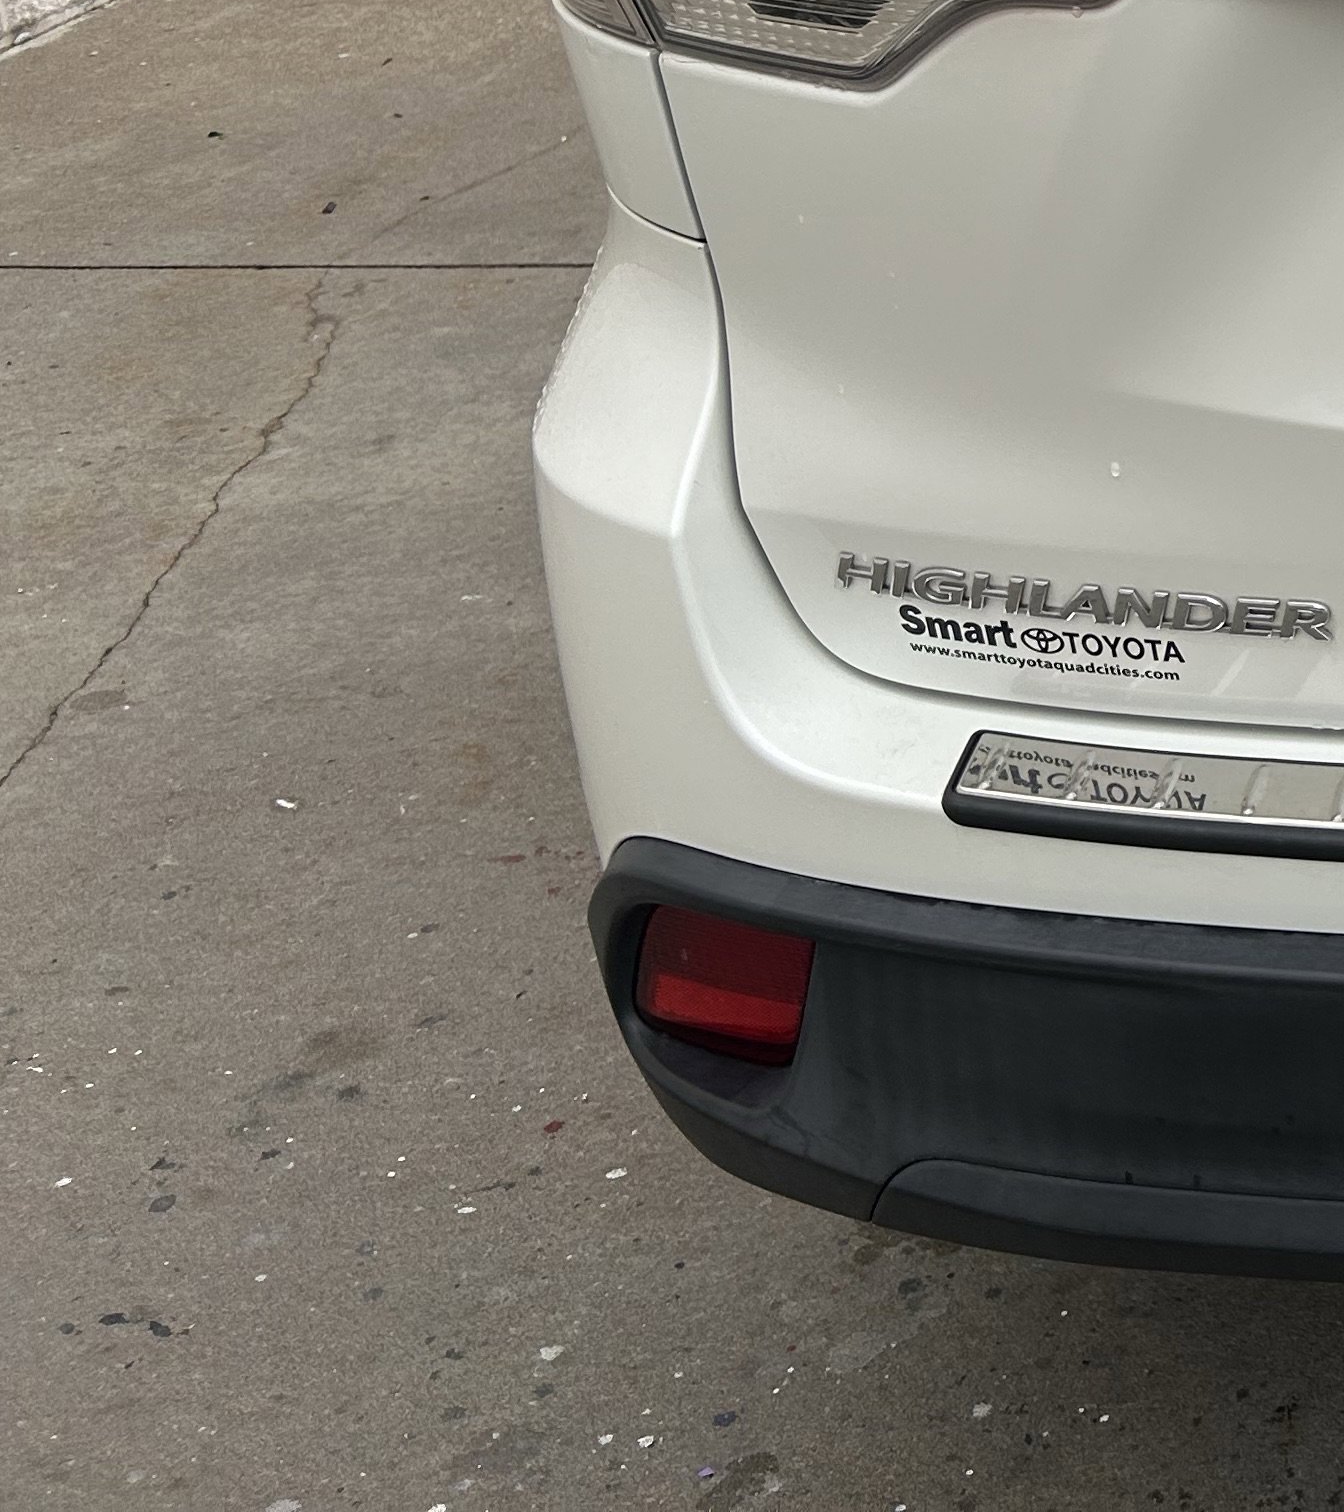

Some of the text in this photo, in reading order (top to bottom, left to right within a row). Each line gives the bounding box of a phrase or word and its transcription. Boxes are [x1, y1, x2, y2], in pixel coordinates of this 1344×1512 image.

[834, 550, 1335, 643] HIGHLANDER
[898, 605, 1186, 664] Smart TOYOTA
[909, 641, 1181, 681] www.smarttoyotaquadcities.com
